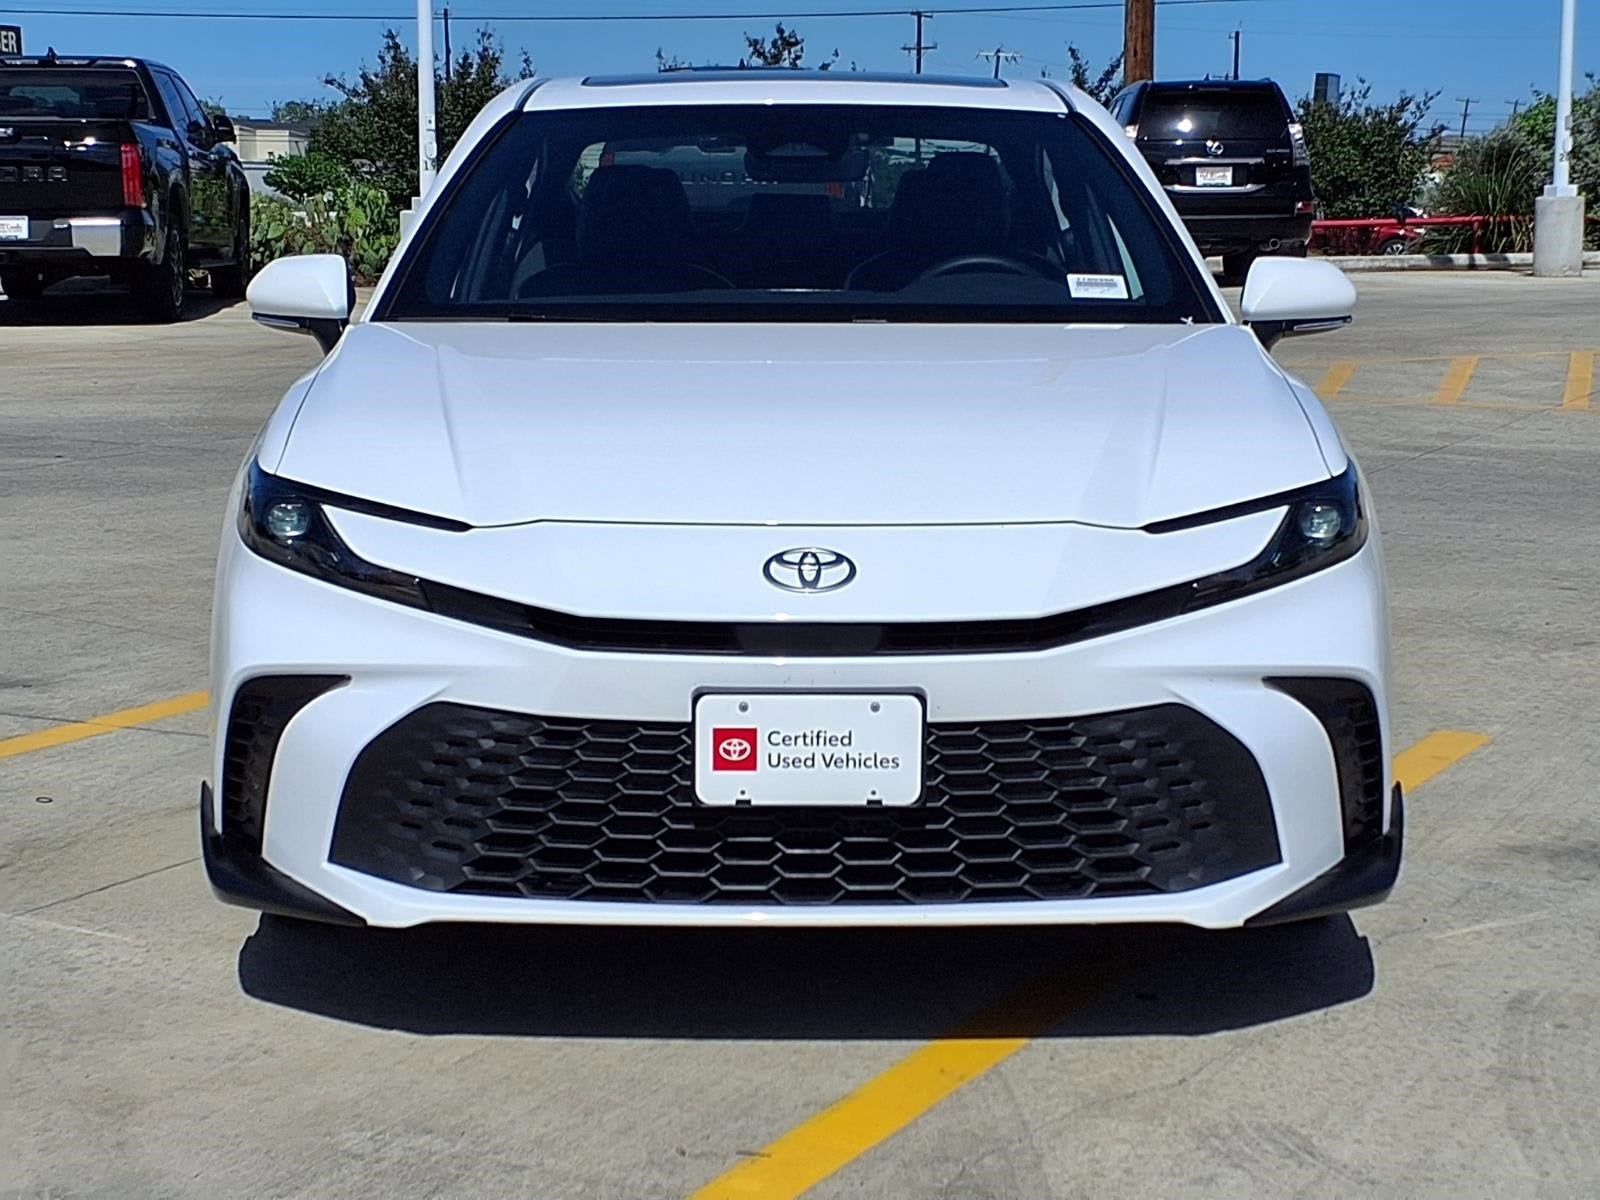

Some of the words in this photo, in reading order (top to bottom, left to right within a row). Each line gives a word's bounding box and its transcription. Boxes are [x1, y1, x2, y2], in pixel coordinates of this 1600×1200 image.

[0, 31, 17, 53] ER
[767, 730, 852, 747] Certified
[768, 752, 815, 768] Used
[821, 752, 900, 769] Vehicles
